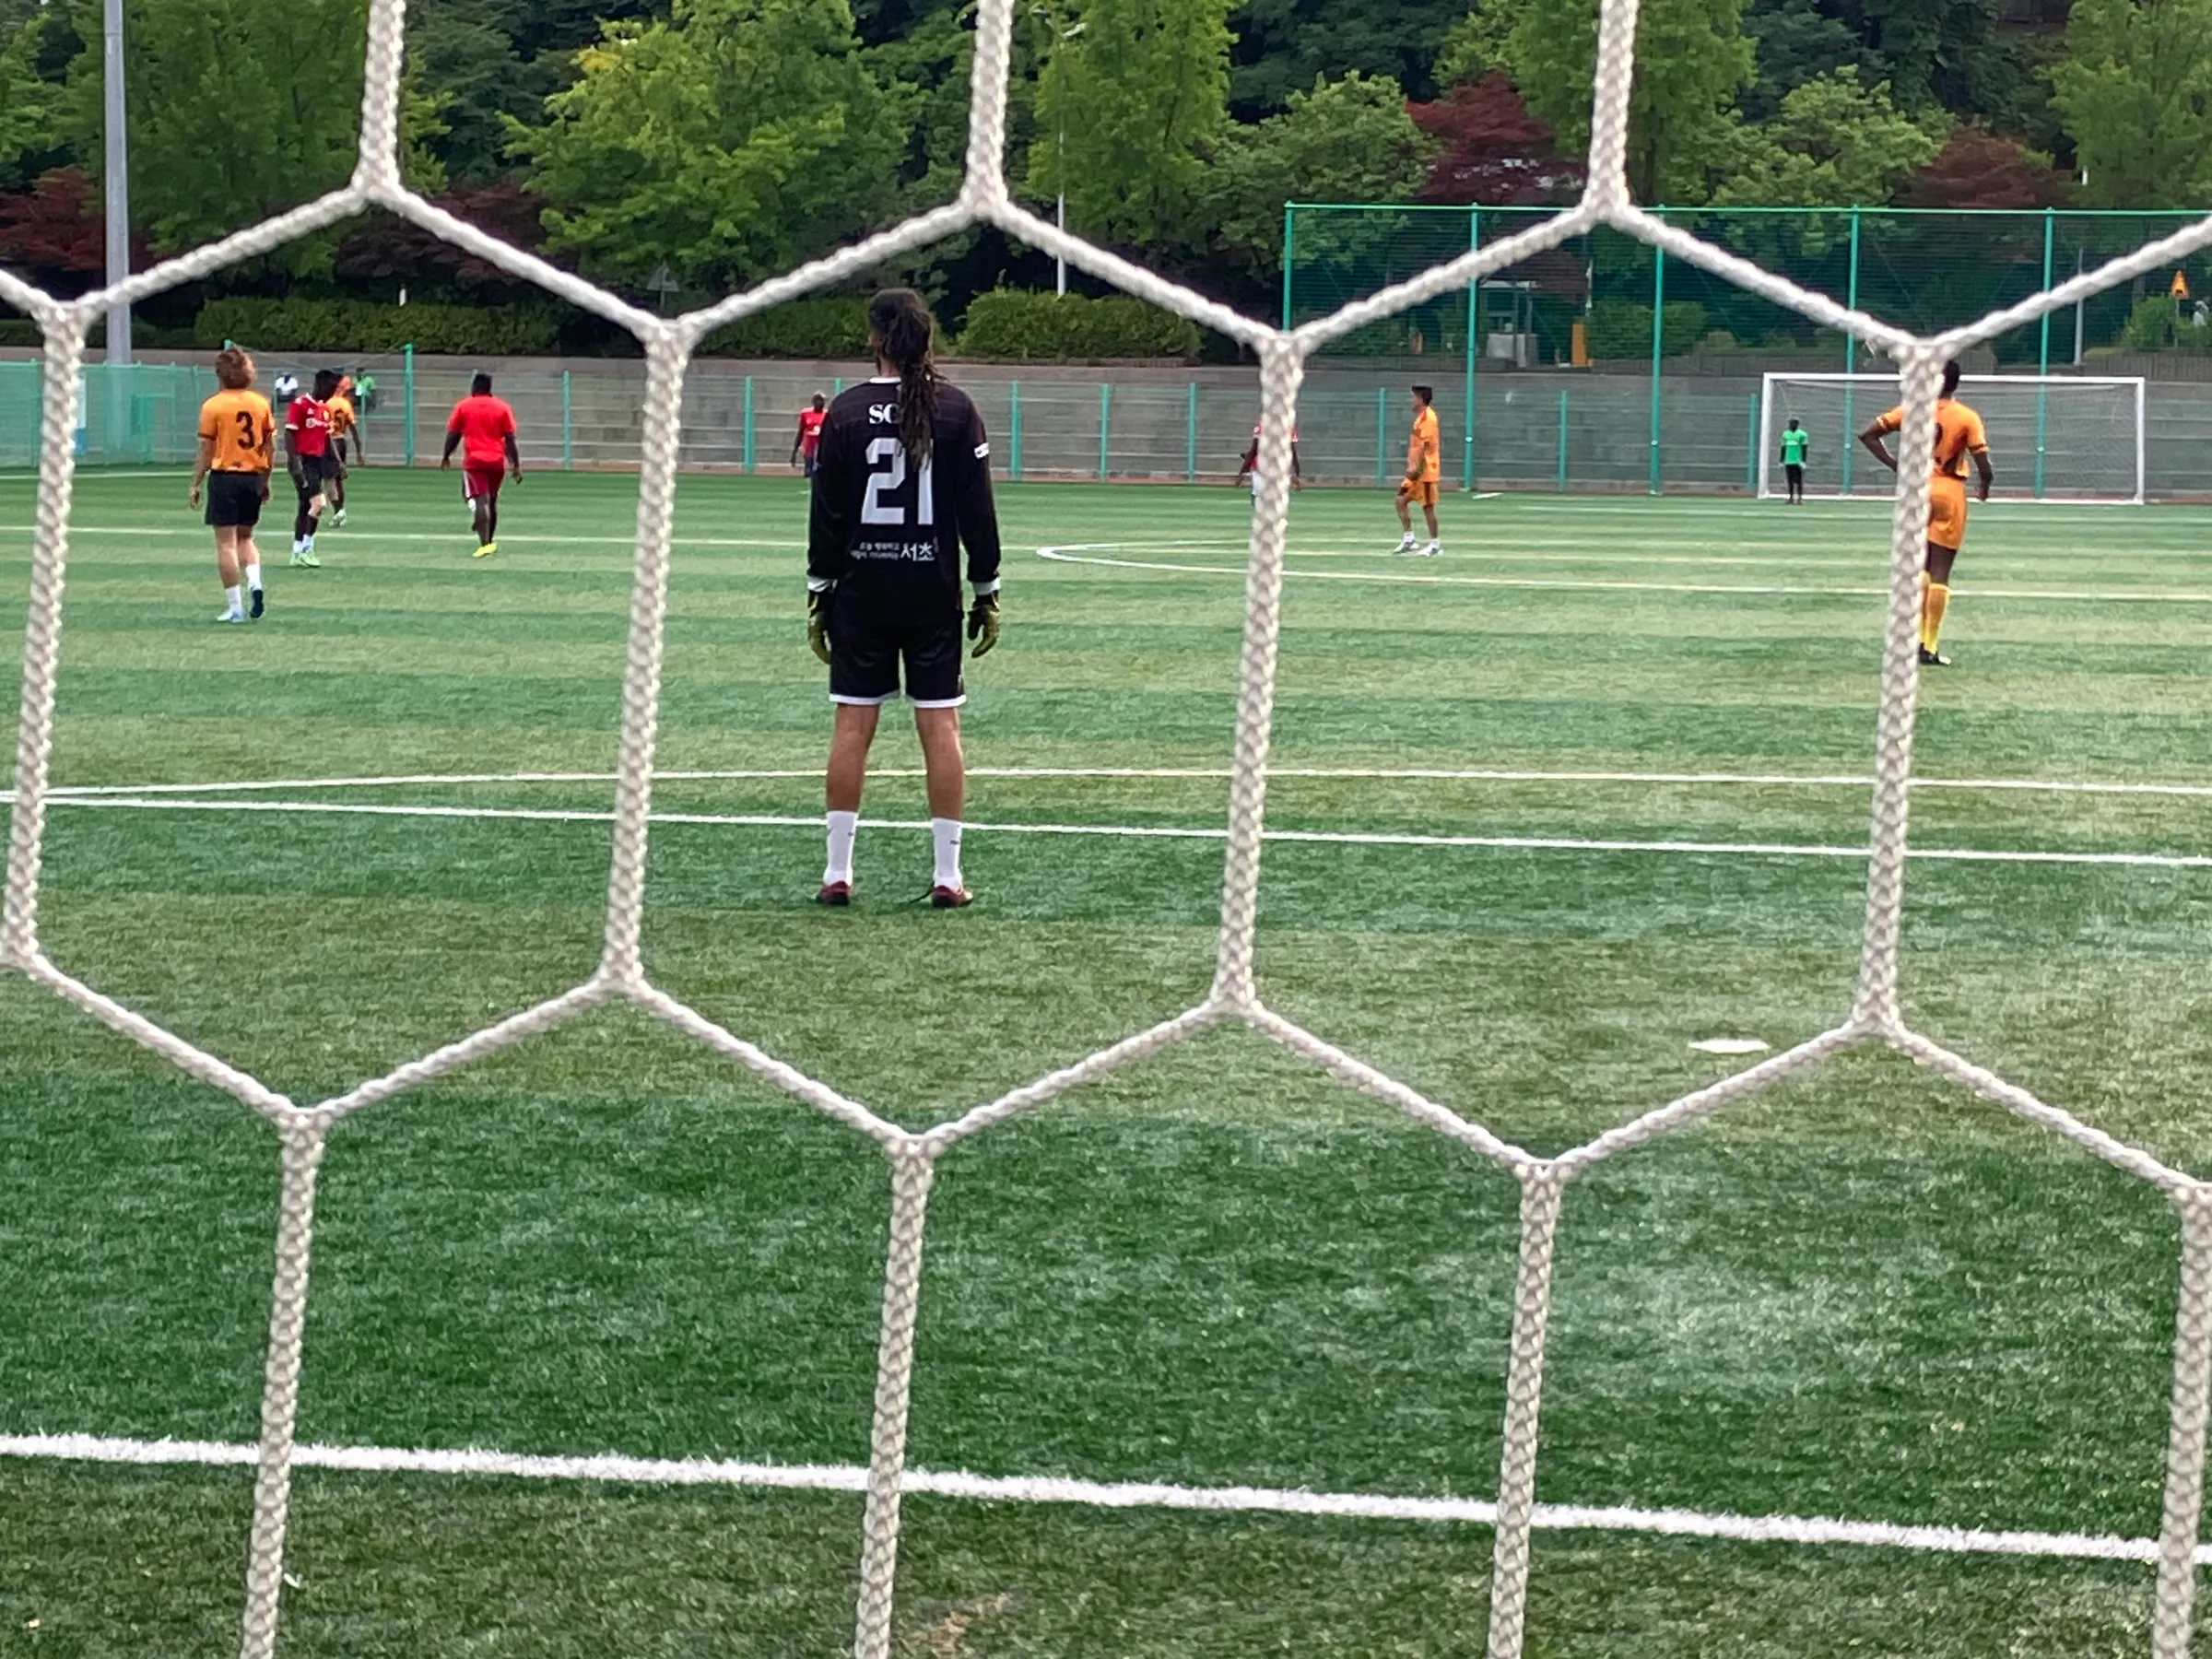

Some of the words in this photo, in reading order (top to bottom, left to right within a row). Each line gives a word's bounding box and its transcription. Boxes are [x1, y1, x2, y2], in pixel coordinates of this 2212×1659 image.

[236, 410, 255, 449] 3
[861, 437, 934, 524] 21
[900, 541, 935, 561] 서초
